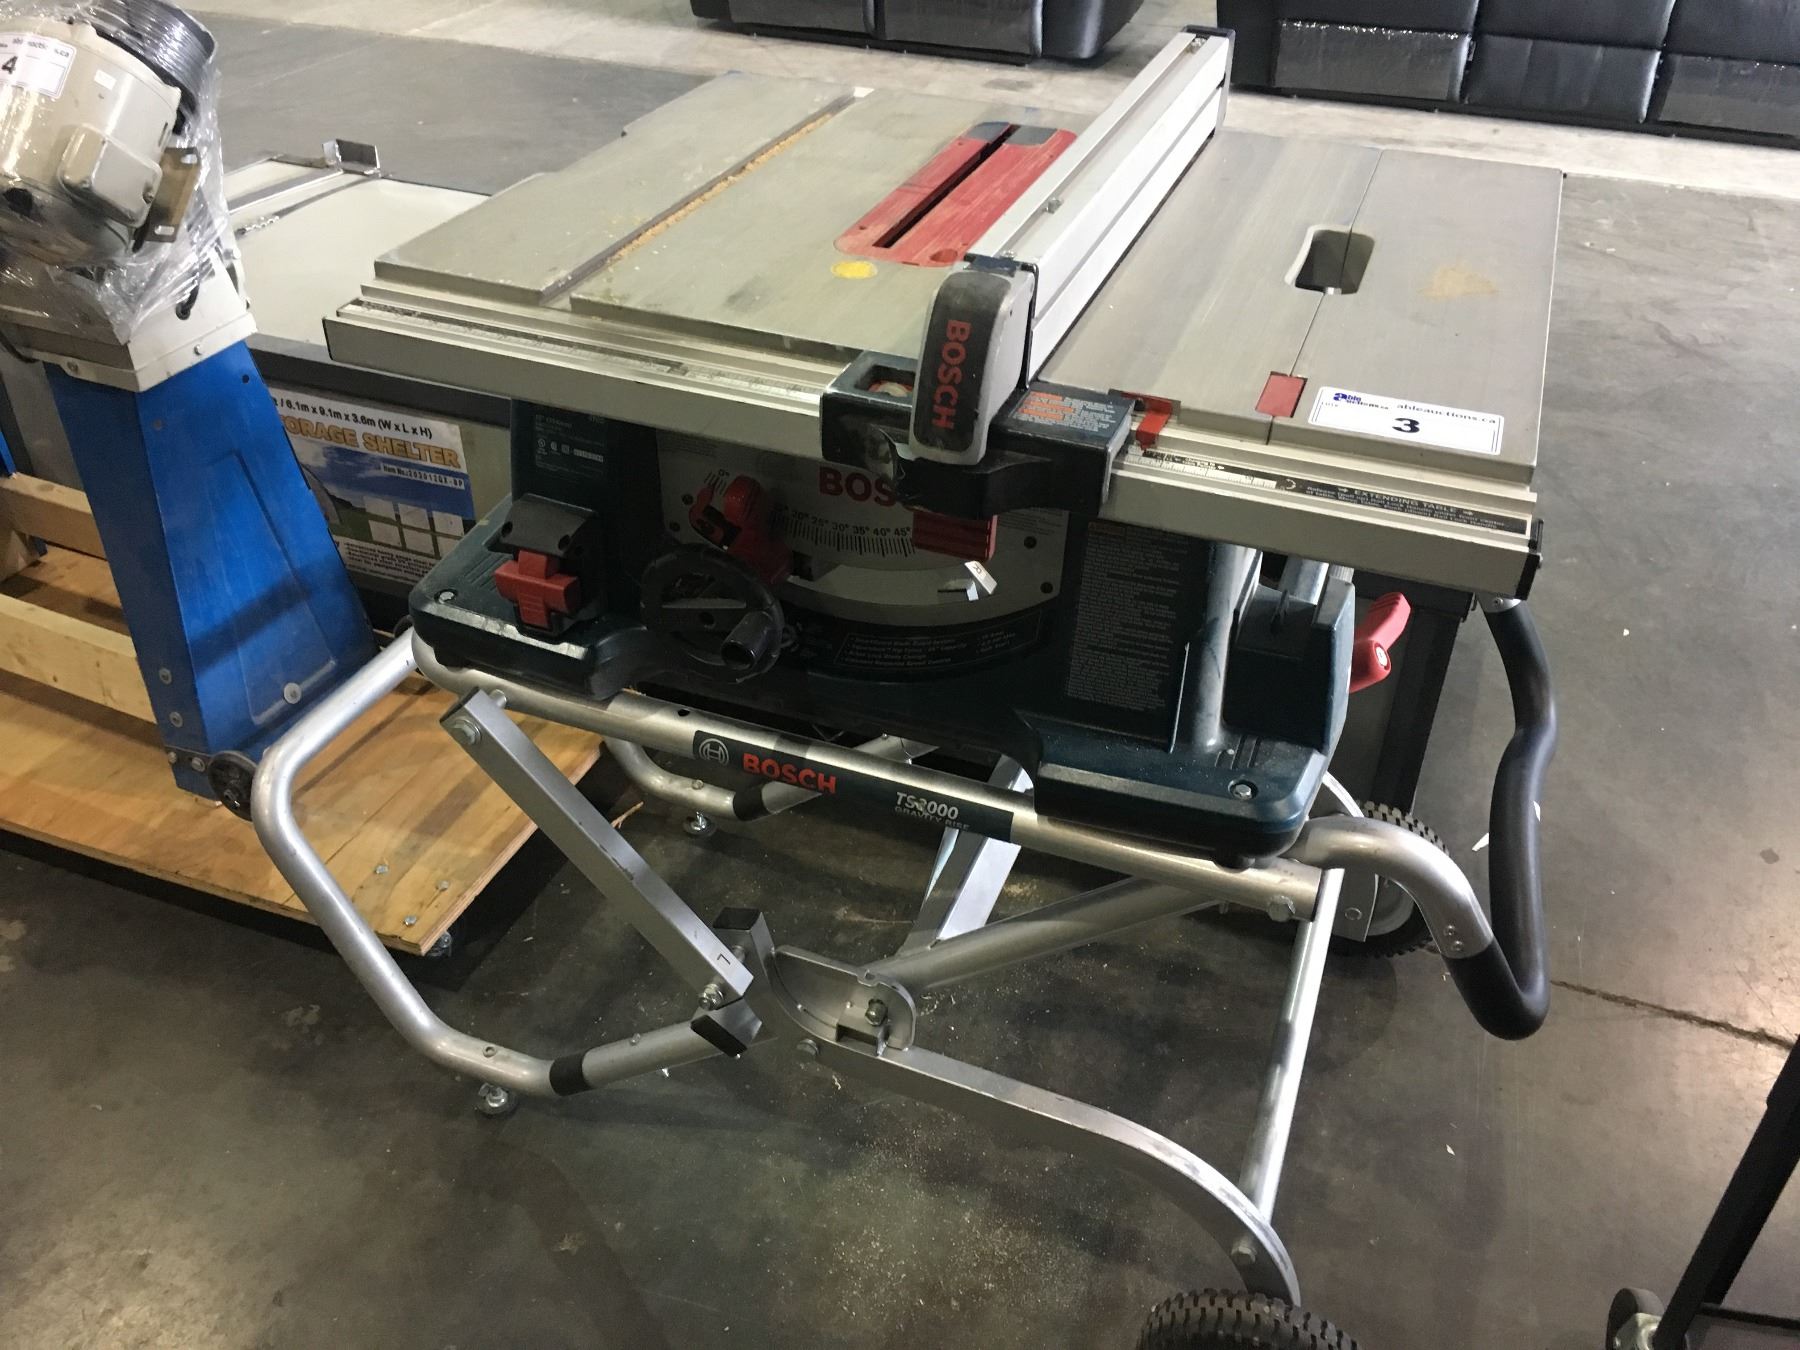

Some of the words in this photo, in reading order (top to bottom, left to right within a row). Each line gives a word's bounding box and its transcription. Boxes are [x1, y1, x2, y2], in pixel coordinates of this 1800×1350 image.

[1, 55, 18, 75] 4
[932, 320, 971, 429] BOSCH
[279, 414, 359, 448] ORAGE
[362, 432, 461, 469] SHELTER
[378, 418, 391, 430] (W
[420, 426, 433, 440] H)
[1392, 417, 1420, 434] 3
[818, 467, 897, 508] BOS
[1354, 490, 1418, 506] EXTENDING
[1423, 502, 1457, 513] TABLE
[743, 752, 837, 794] BOSCH
